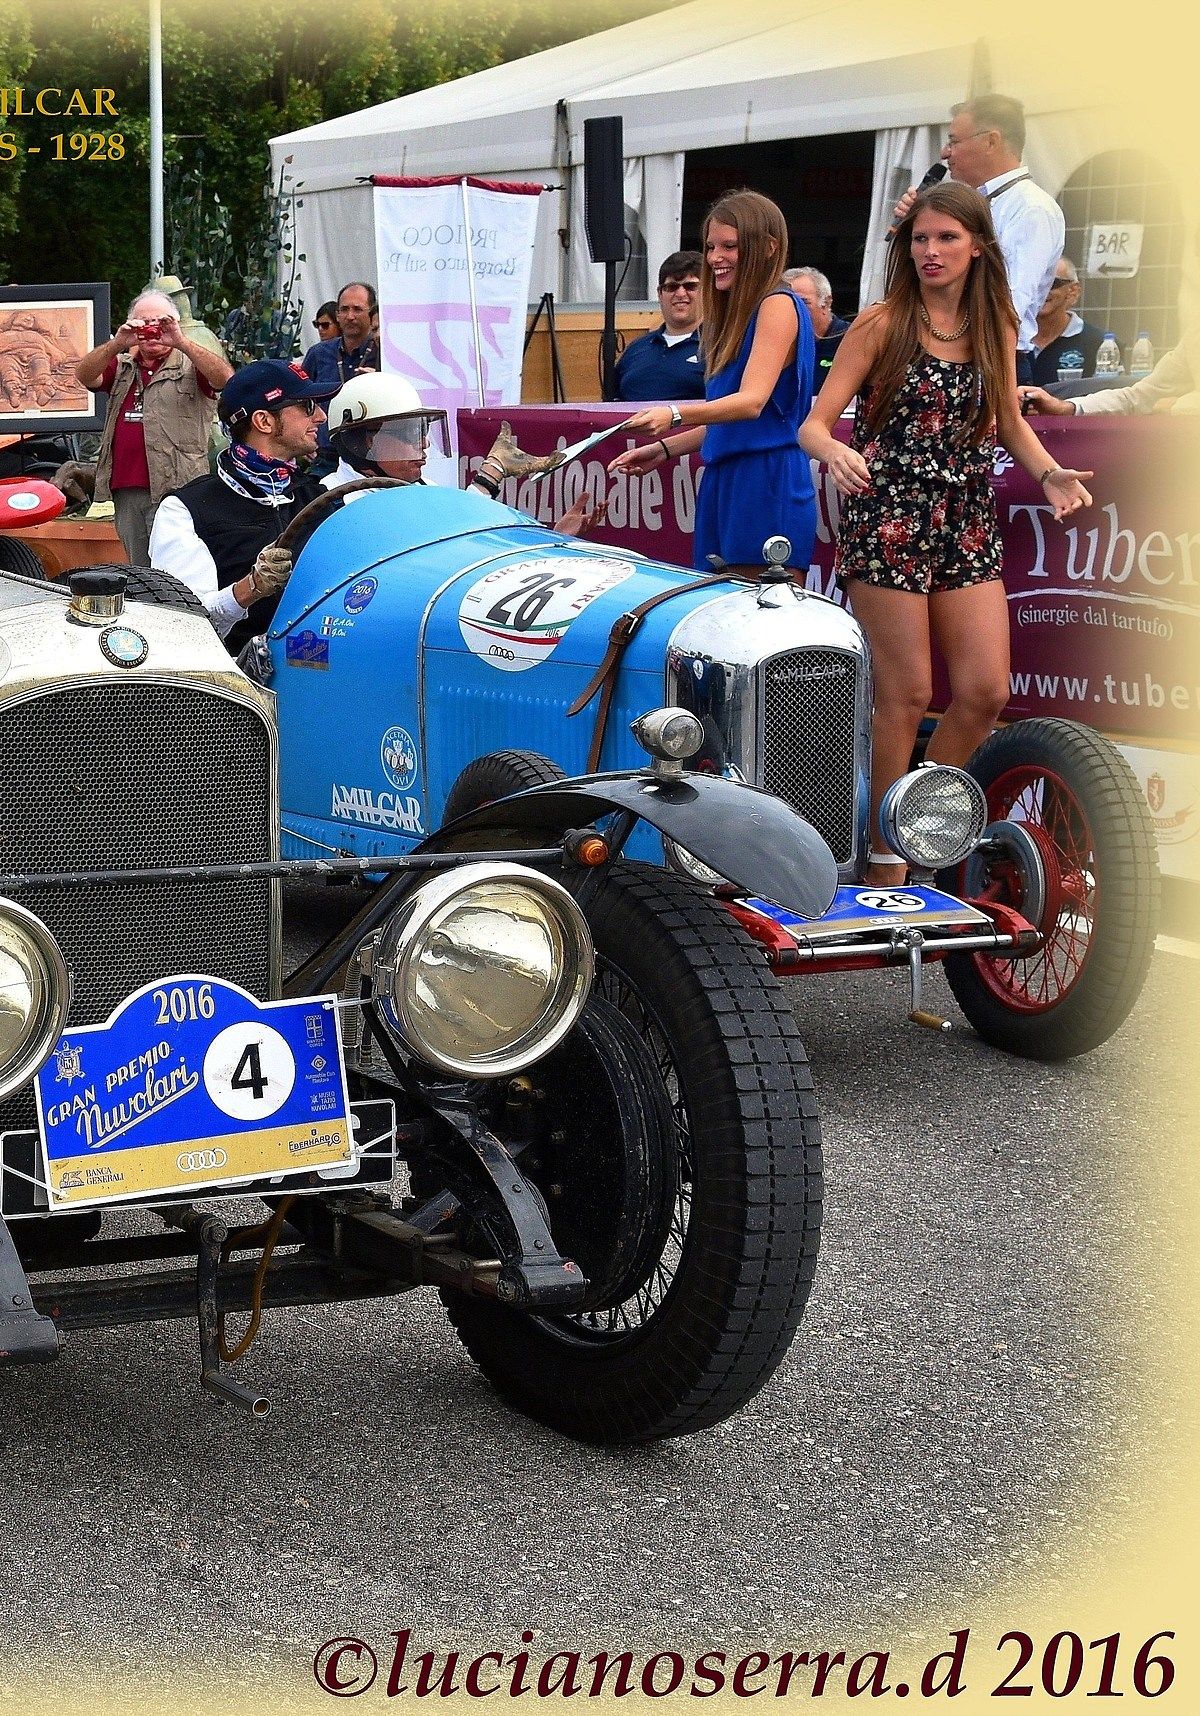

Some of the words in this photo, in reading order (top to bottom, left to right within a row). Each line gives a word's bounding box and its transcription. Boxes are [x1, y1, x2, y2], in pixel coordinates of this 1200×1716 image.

[1096, 232, 1129, 255] BAR
[352, 585, 372, 595] 2016
[484, 560, 547, 584] GRAN
[486, 573, 577, 632] 26
[1017, 604, 1078, 627] (sinergie
[1084, 606, 1108, 627] dal
[1112, 611, 1174, 641] tartufo)
[777, 664, 844, 683] AMILCAR
[1009, 672, 1200, 710] www.tube
[330, 783, 425, 834] AMILCAR
[862, 894, 921, 910] 26
[153, 984, 215, 1026] 2016
[47, 1084, 96, 1127] GRAN
[106, 1041, 170, 1092] PREMIO
[231, 1042, 268, 1100] 4
[76, 1057, 199, 1147] Nuvolari
[85, 1166, 112, 1178] BANCA
[86, 1172, 125, 1187] GENERALI
